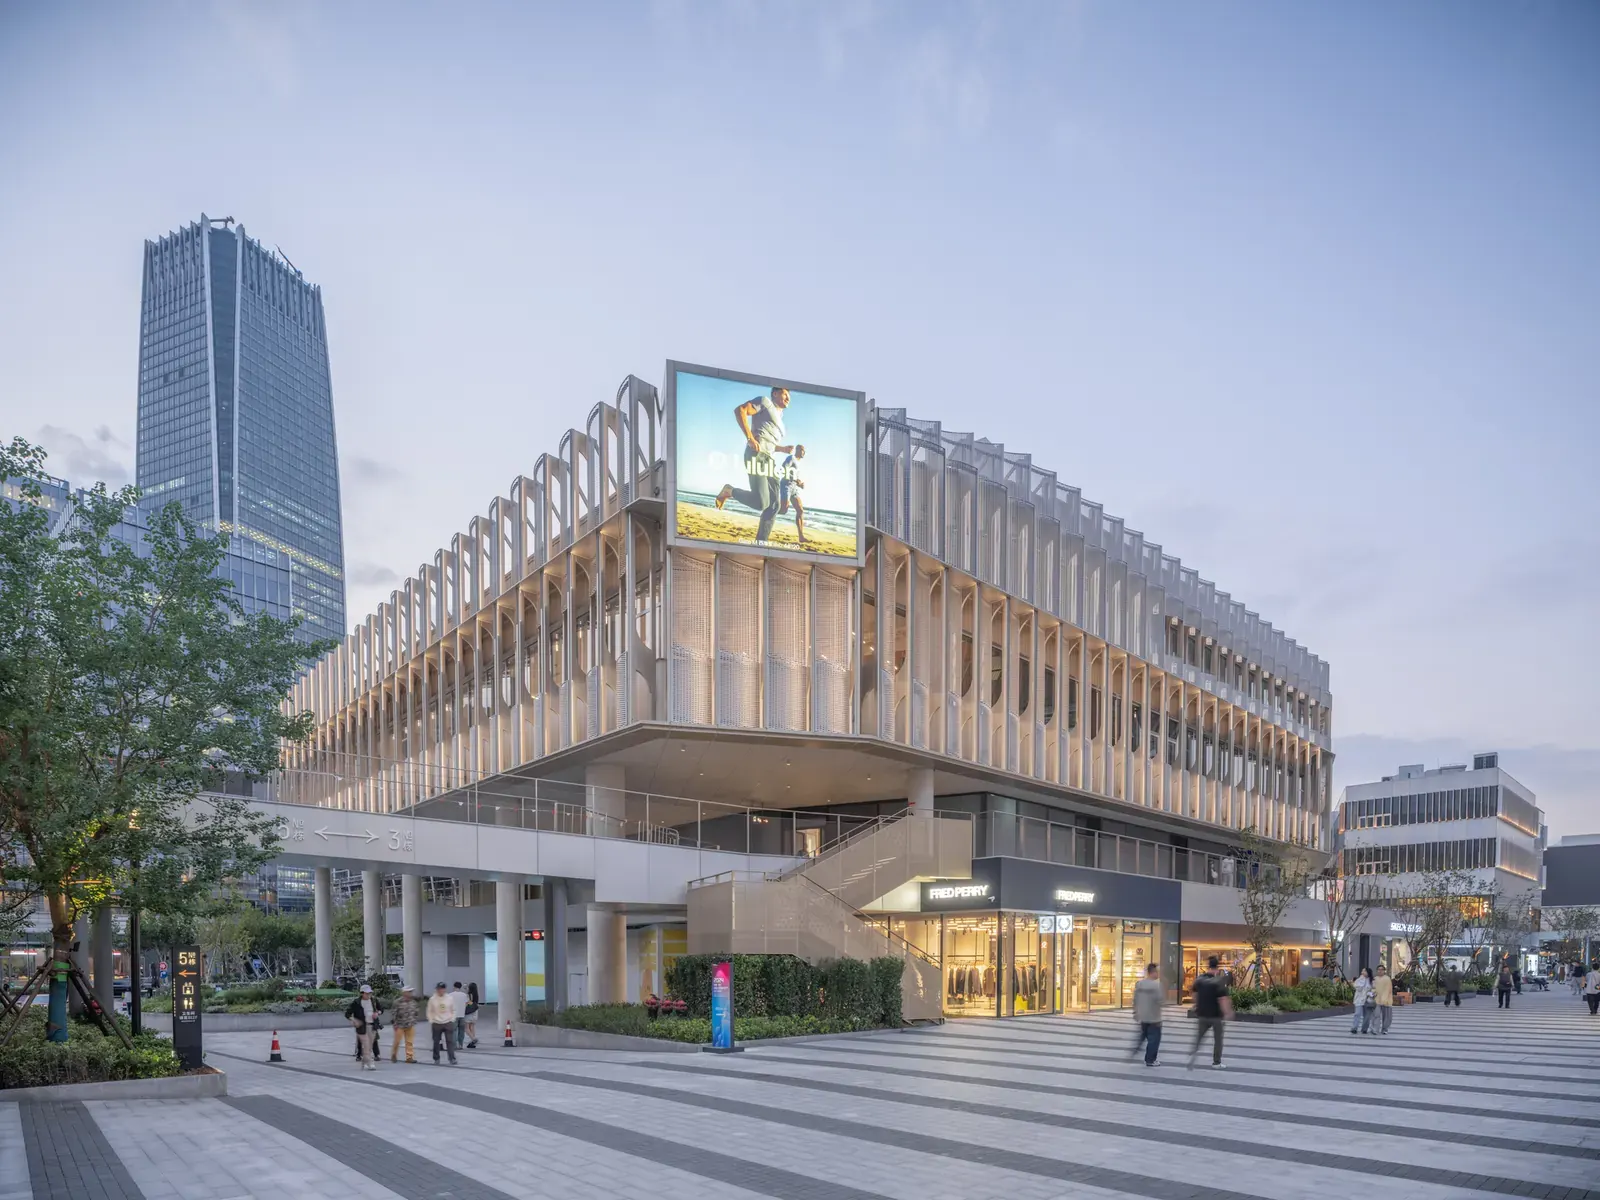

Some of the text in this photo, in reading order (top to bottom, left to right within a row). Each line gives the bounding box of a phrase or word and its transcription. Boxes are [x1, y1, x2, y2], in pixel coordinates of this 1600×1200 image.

[388, 829, 400, 850] 3
[929, 885, 989, 900] FRED PERRY
[1057, 889, 1074, 901] FRED
[179, 951, 188, 965] 5
